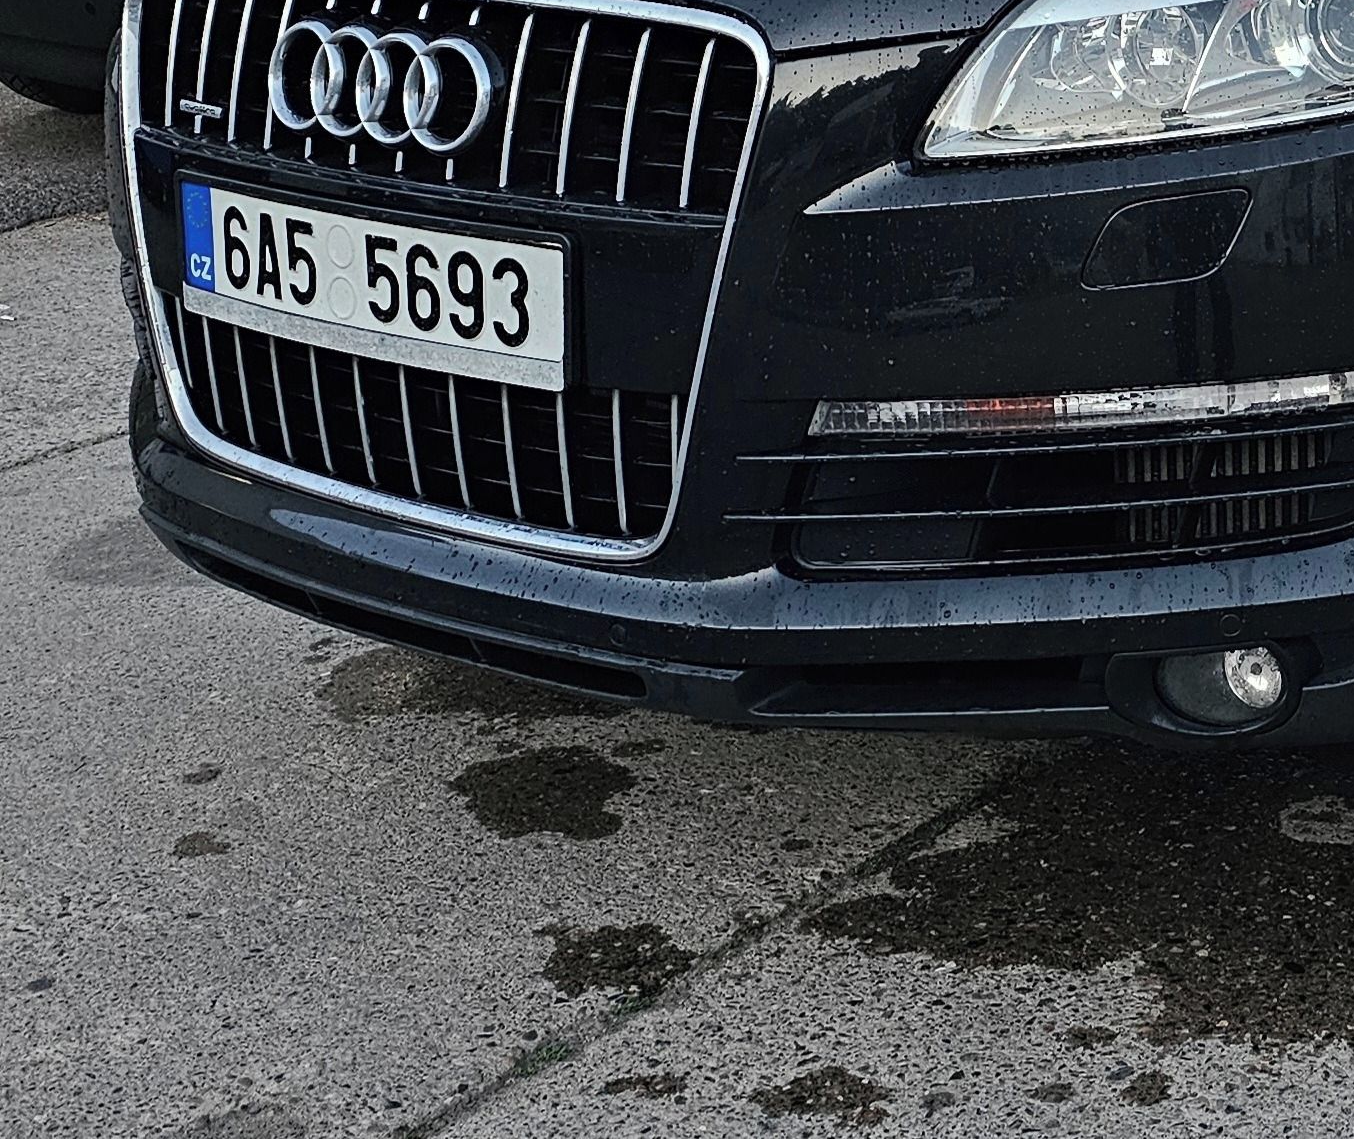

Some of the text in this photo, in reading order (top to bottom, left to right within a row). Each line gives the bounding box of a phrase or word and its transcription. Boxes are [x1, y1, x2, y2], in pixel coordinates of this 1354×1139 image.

[189, 253, 212, 281] CZ
[223, 205, 530, 348] 6A5 5693
